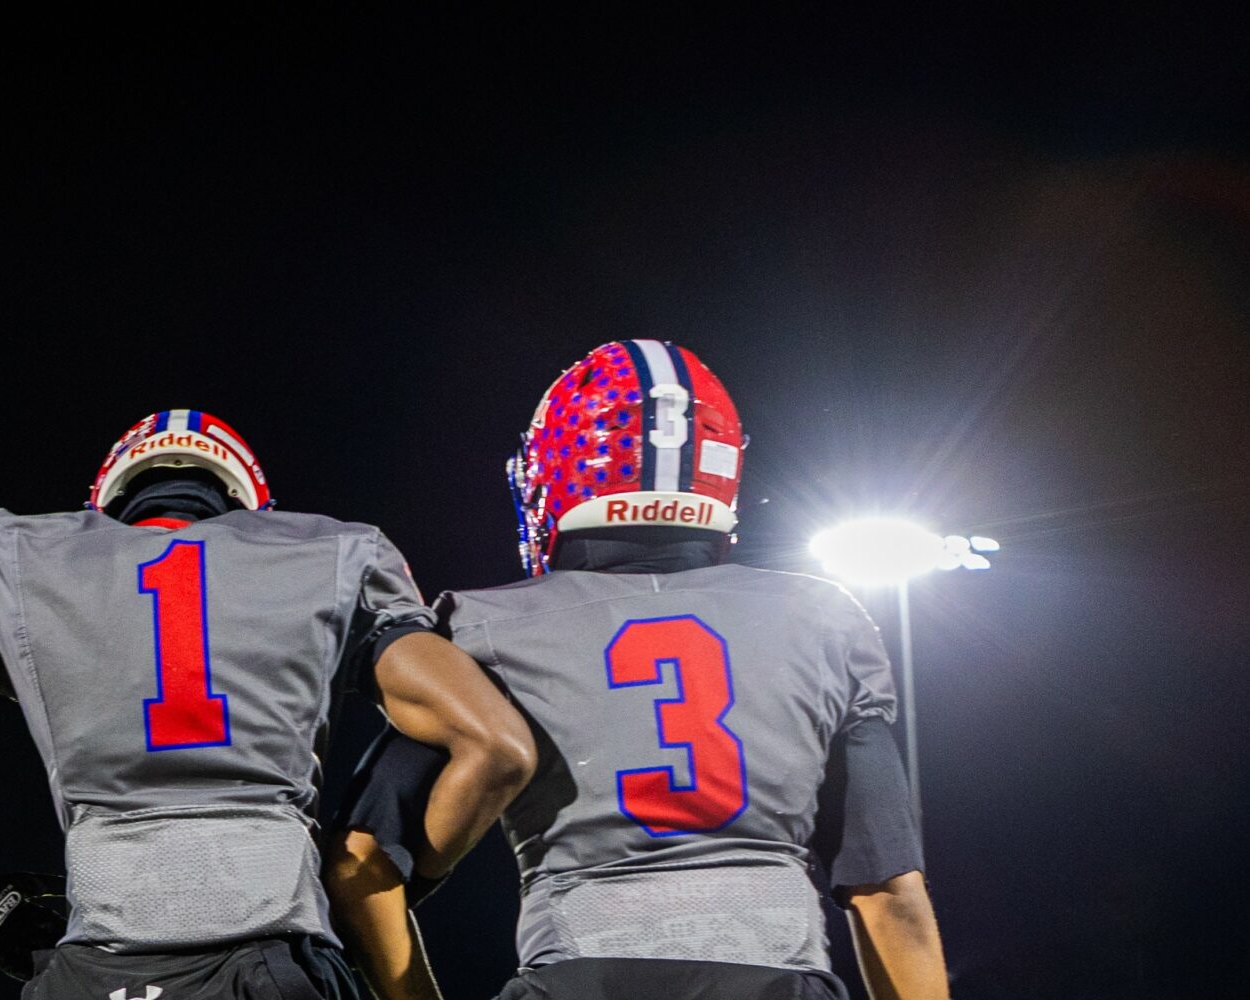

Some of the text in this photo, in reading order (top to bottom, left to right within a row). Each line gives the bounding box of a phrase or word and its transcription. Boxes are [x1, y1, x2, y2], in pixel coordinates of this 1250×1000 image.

[128, 433, 230, 461] Riddell
[649, 383, 689, 449] 3
[606, 499, 714, 526] Riddell
[137, 538, 232, 752] 1
[603, 613, 749, 838] 3
